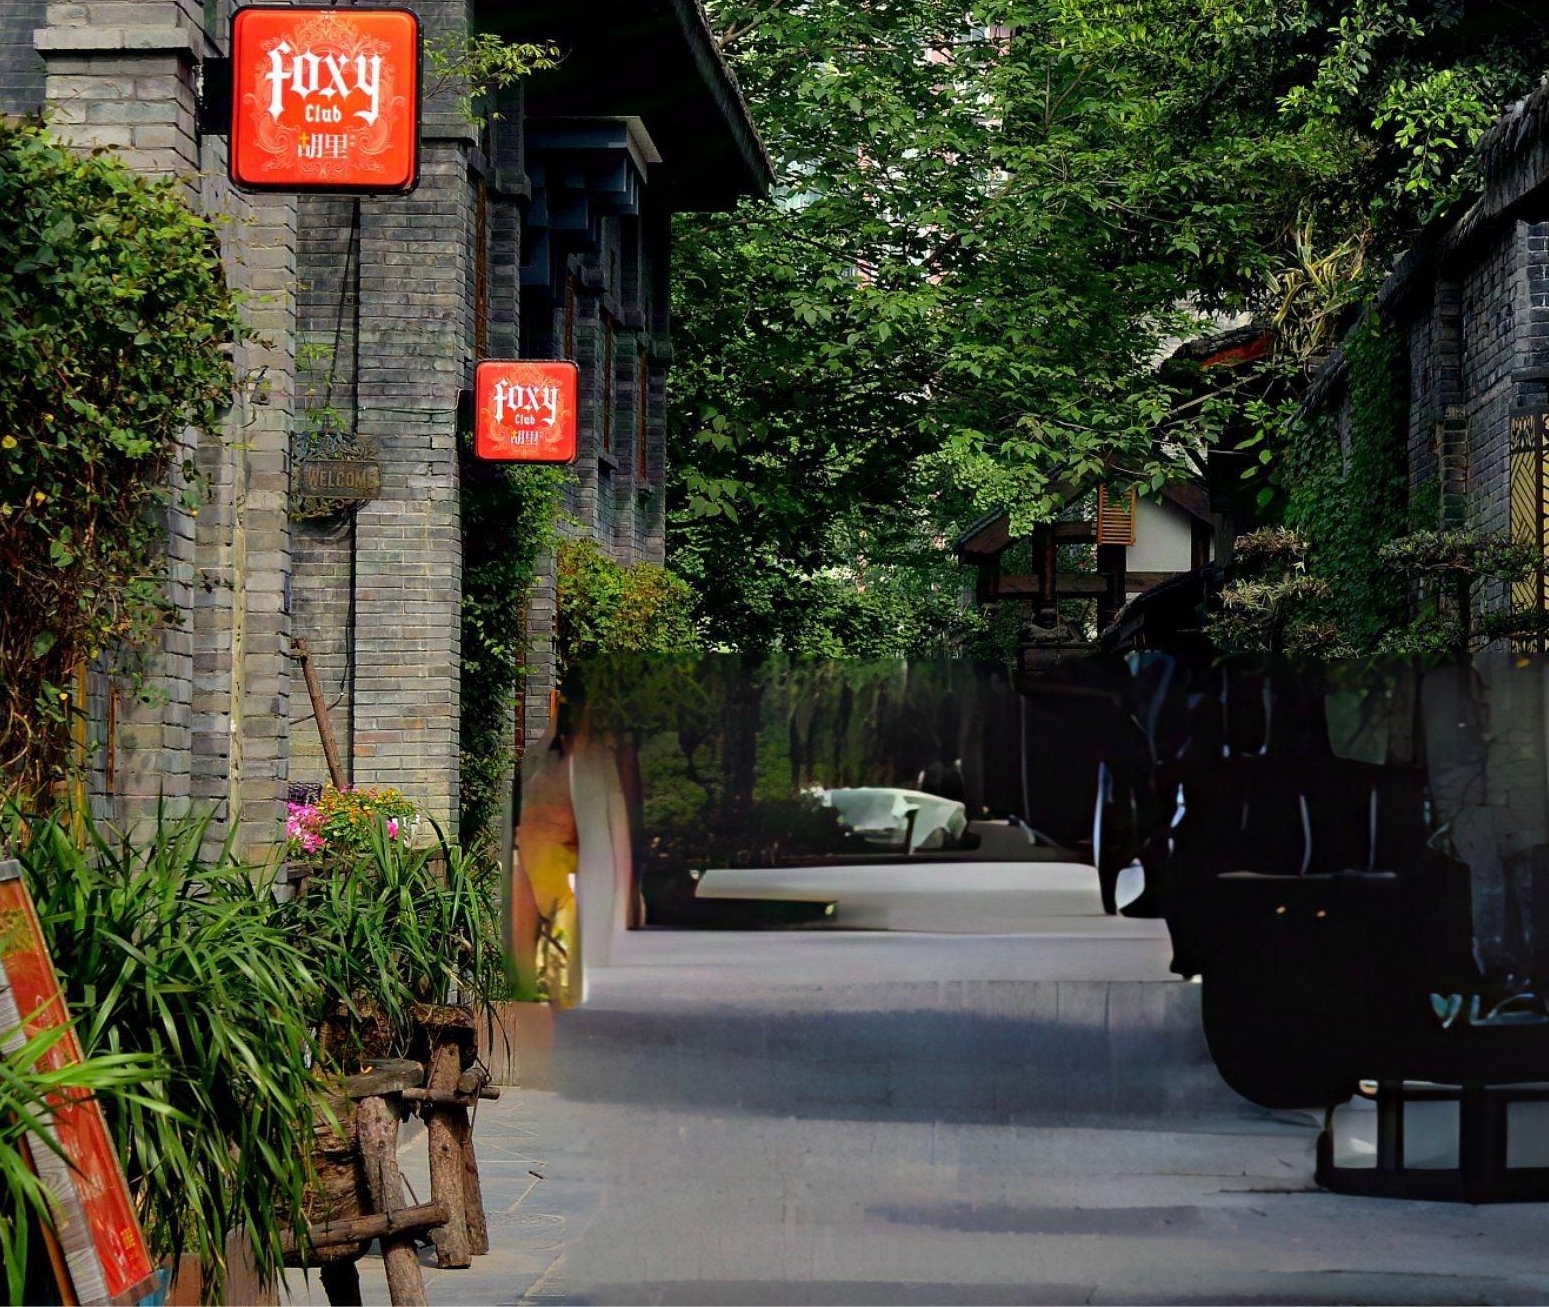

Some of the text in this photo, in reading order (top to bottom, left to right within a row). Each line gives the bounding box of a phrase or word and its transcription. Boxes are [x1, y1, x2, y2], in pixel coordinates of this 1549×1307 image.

[264, 41, 385, 127] foxy
[304, 104, 342, 123] Club
[493, 378, 559, 427] foxy
[514, 414, 536, 425] Club
